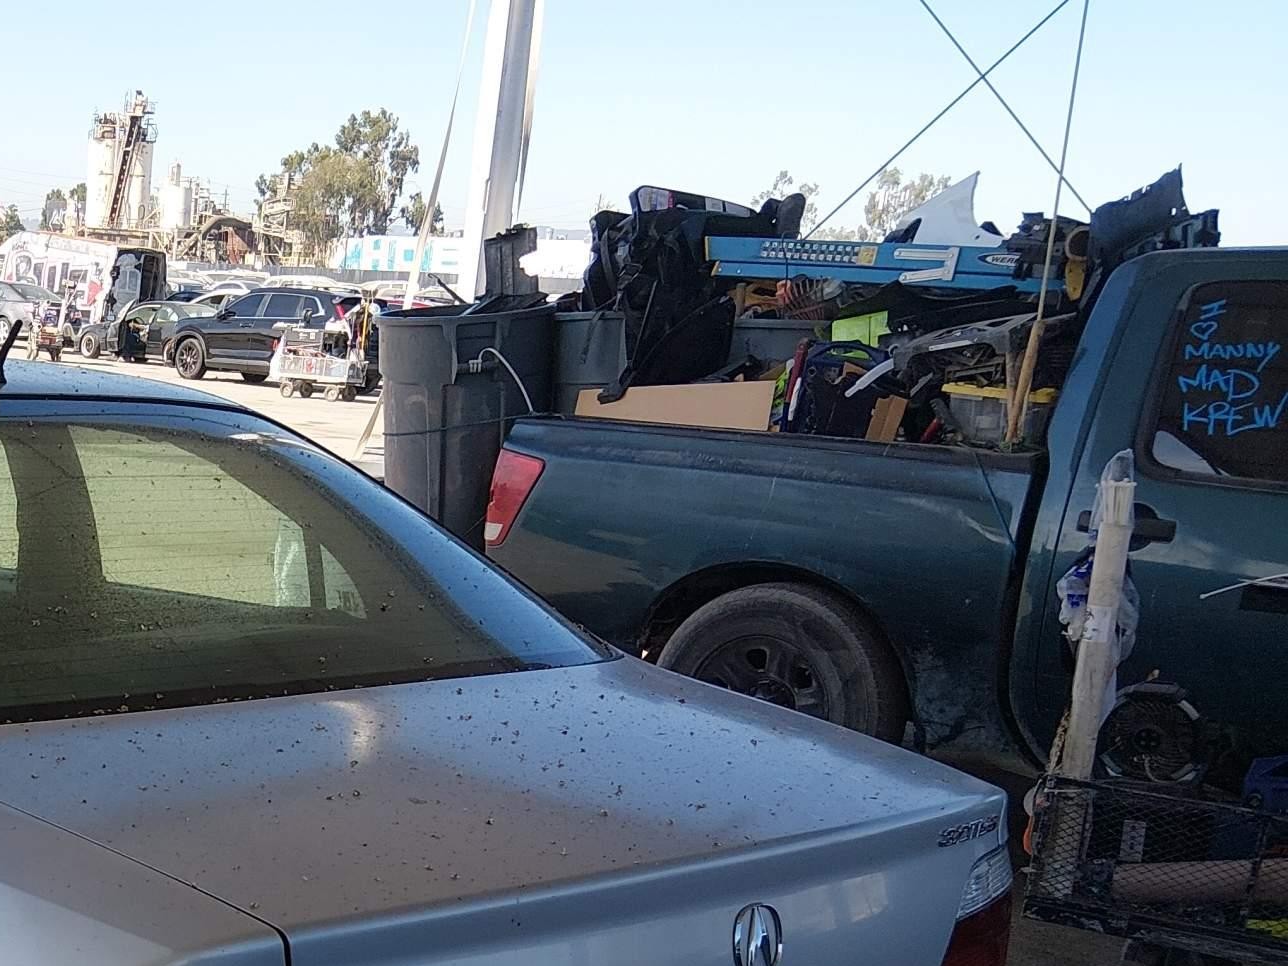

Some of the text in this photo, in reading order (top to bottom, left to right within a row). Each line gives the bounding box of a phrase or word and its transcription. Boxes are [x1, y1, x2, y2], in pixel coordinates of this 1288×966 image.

[1184, 341, 1281, 373] MANNY
[1177, 364, 1260, 401] MAD
[1183, 392, 1288, 436] KREW
